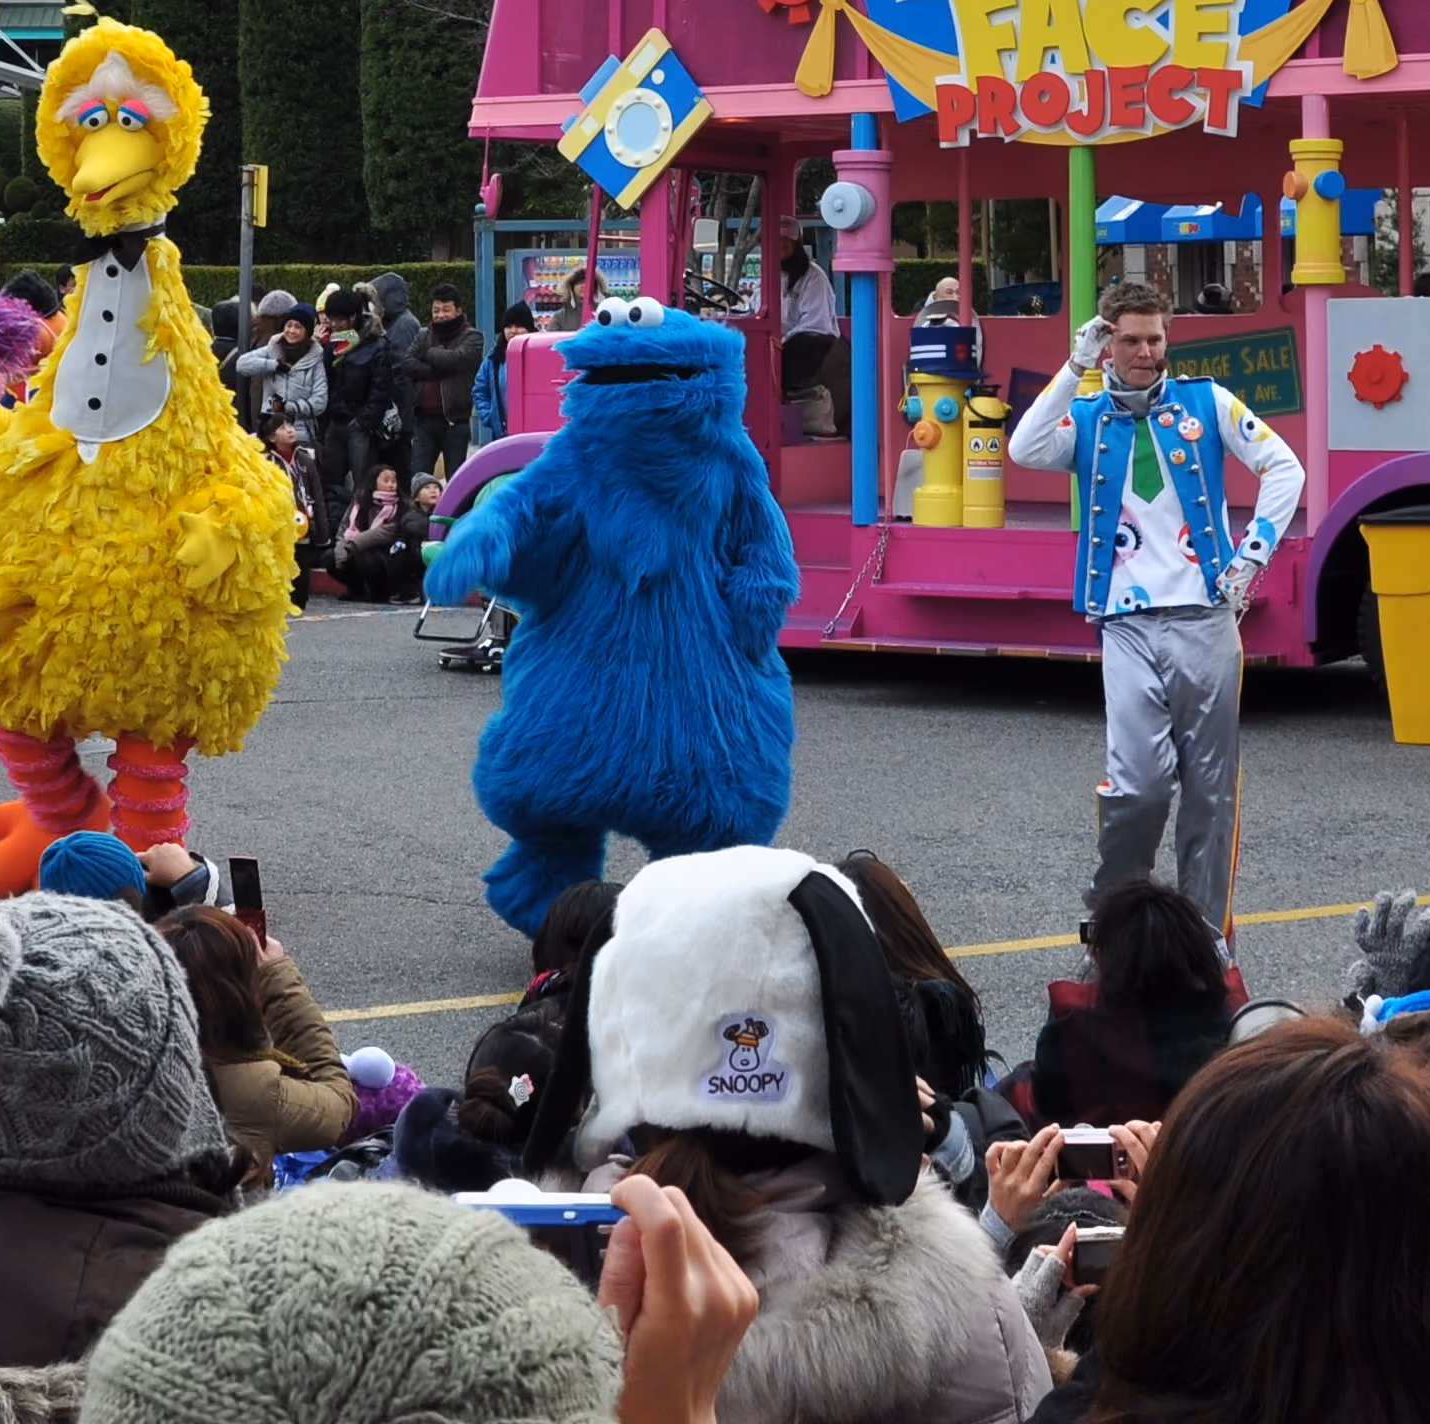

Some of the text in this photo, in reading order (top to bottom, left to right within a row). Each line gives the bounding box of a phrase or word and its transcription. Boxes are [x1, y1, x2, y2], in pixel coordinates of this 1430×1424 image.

[935, 64, 1243, 143] PROJECT
[1240, 346, 1292, 375] SALE
[708, 1072, 785, 1095] SNOOPY
